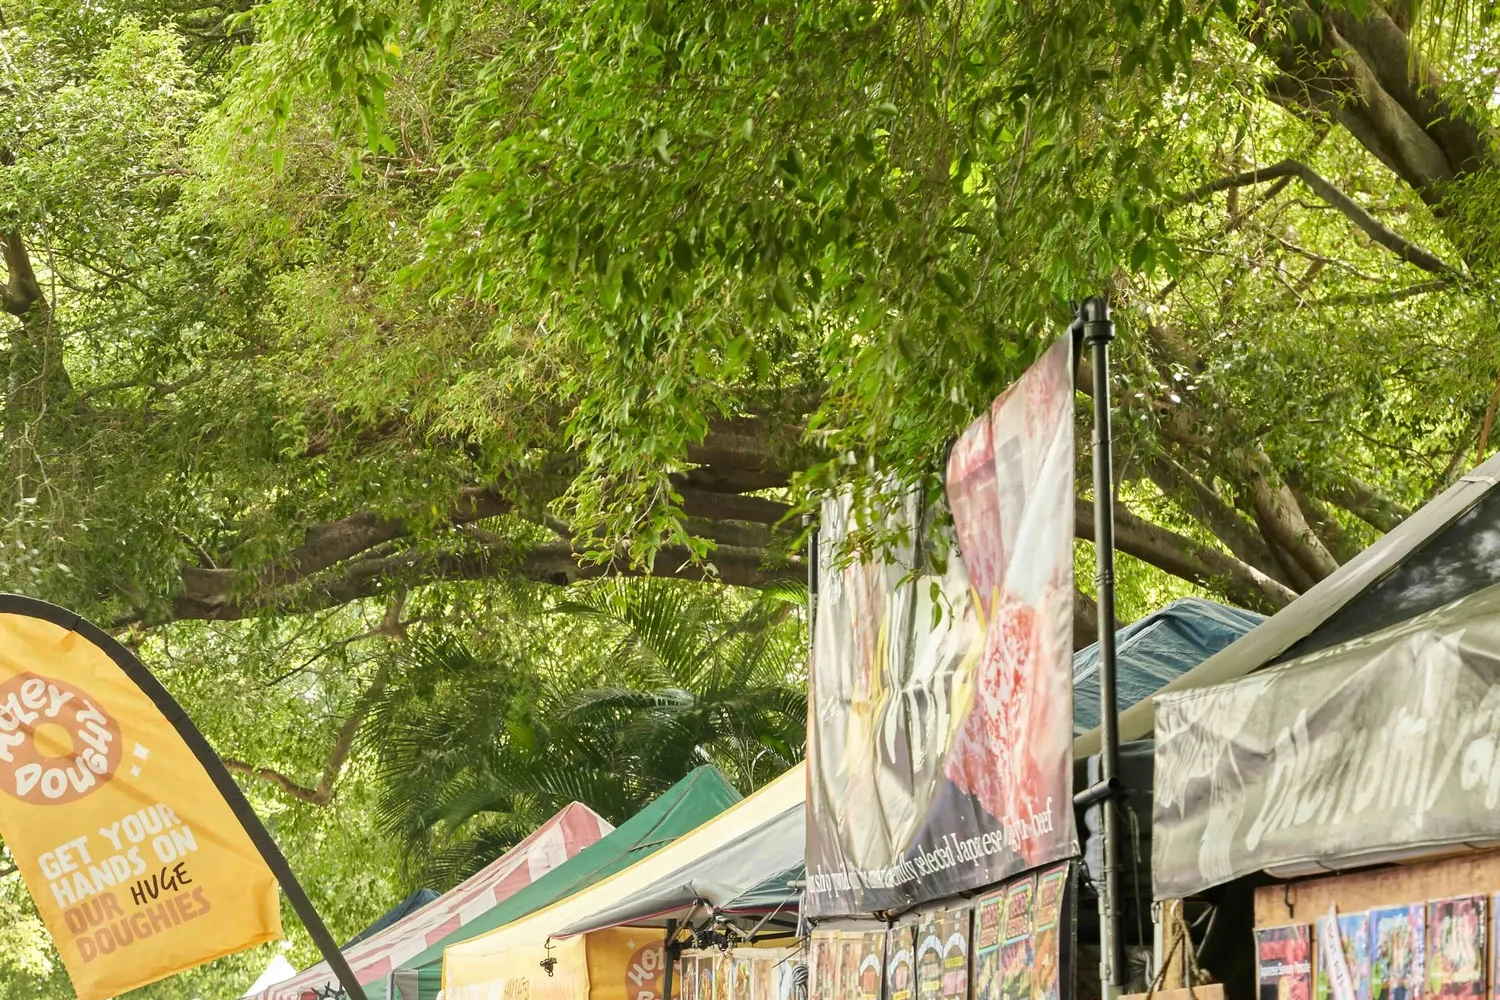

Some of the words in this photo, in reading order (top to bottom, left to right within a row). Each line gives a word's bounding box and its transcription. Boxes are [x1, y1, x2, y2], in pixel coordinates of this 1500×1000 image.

[38, 836, 92, 880] GET
[99, 803, 181, 850] YOUR
[51, 847, 147, 909] HANDS
[153, 825, 198, 864] ON
[915, 836, 957, 876] selected
[64, 892, 125, 935] OUR
[130, 862, 192, 905] HUGE
[75, 886, 211, 964] DOUGHIES
